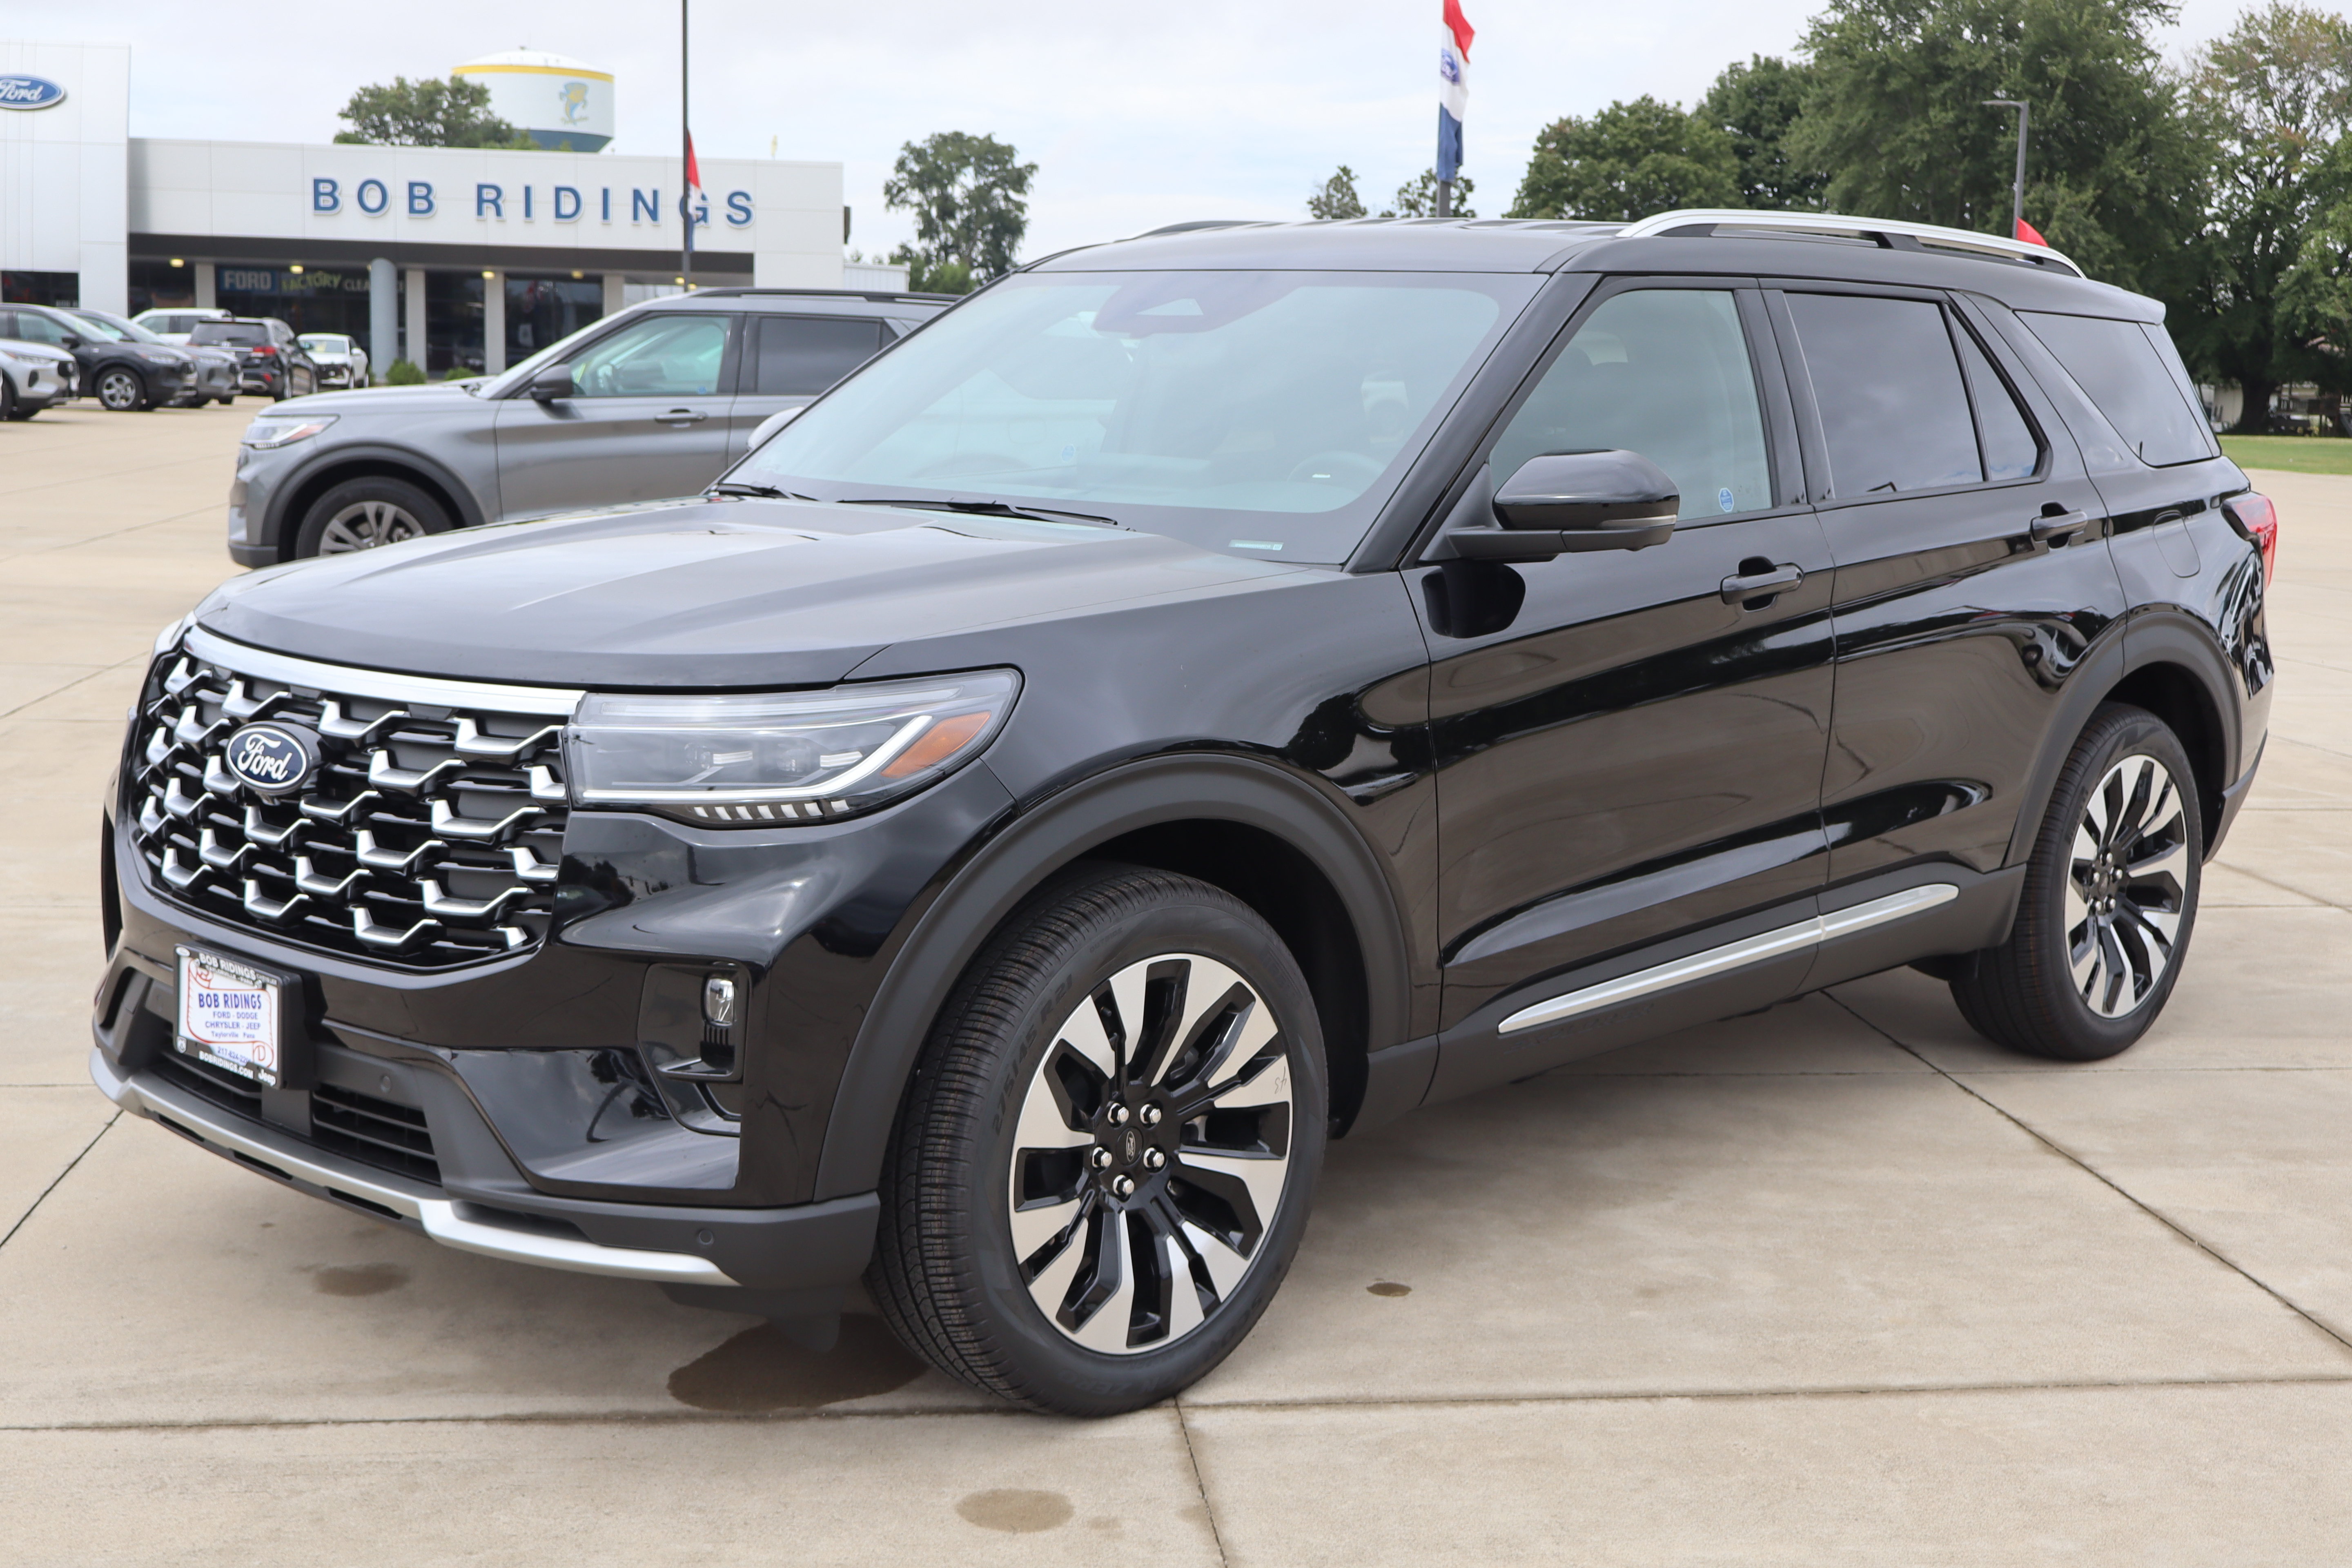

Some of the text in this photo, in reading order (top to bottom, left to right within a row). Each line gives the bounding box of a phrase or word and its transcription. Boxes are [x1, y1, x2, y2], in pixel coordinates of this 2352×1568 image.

[0, 79, 44, 101] Ford
[313, 177, 436, 217] BOB
[224, 270, 272, 290] FORD
[237, 733, 292, 781] Ford
[199, 953, 256, 980] BOB RIDINGS
[198, 993, 261, 1009] BOB RIDINGS
[199, 1050, 254, 1080] BOBRIDINGS.COM
[258, 1069, 276, 1087] Jeep
[992, 1024, 1038, 1136] 275/45
